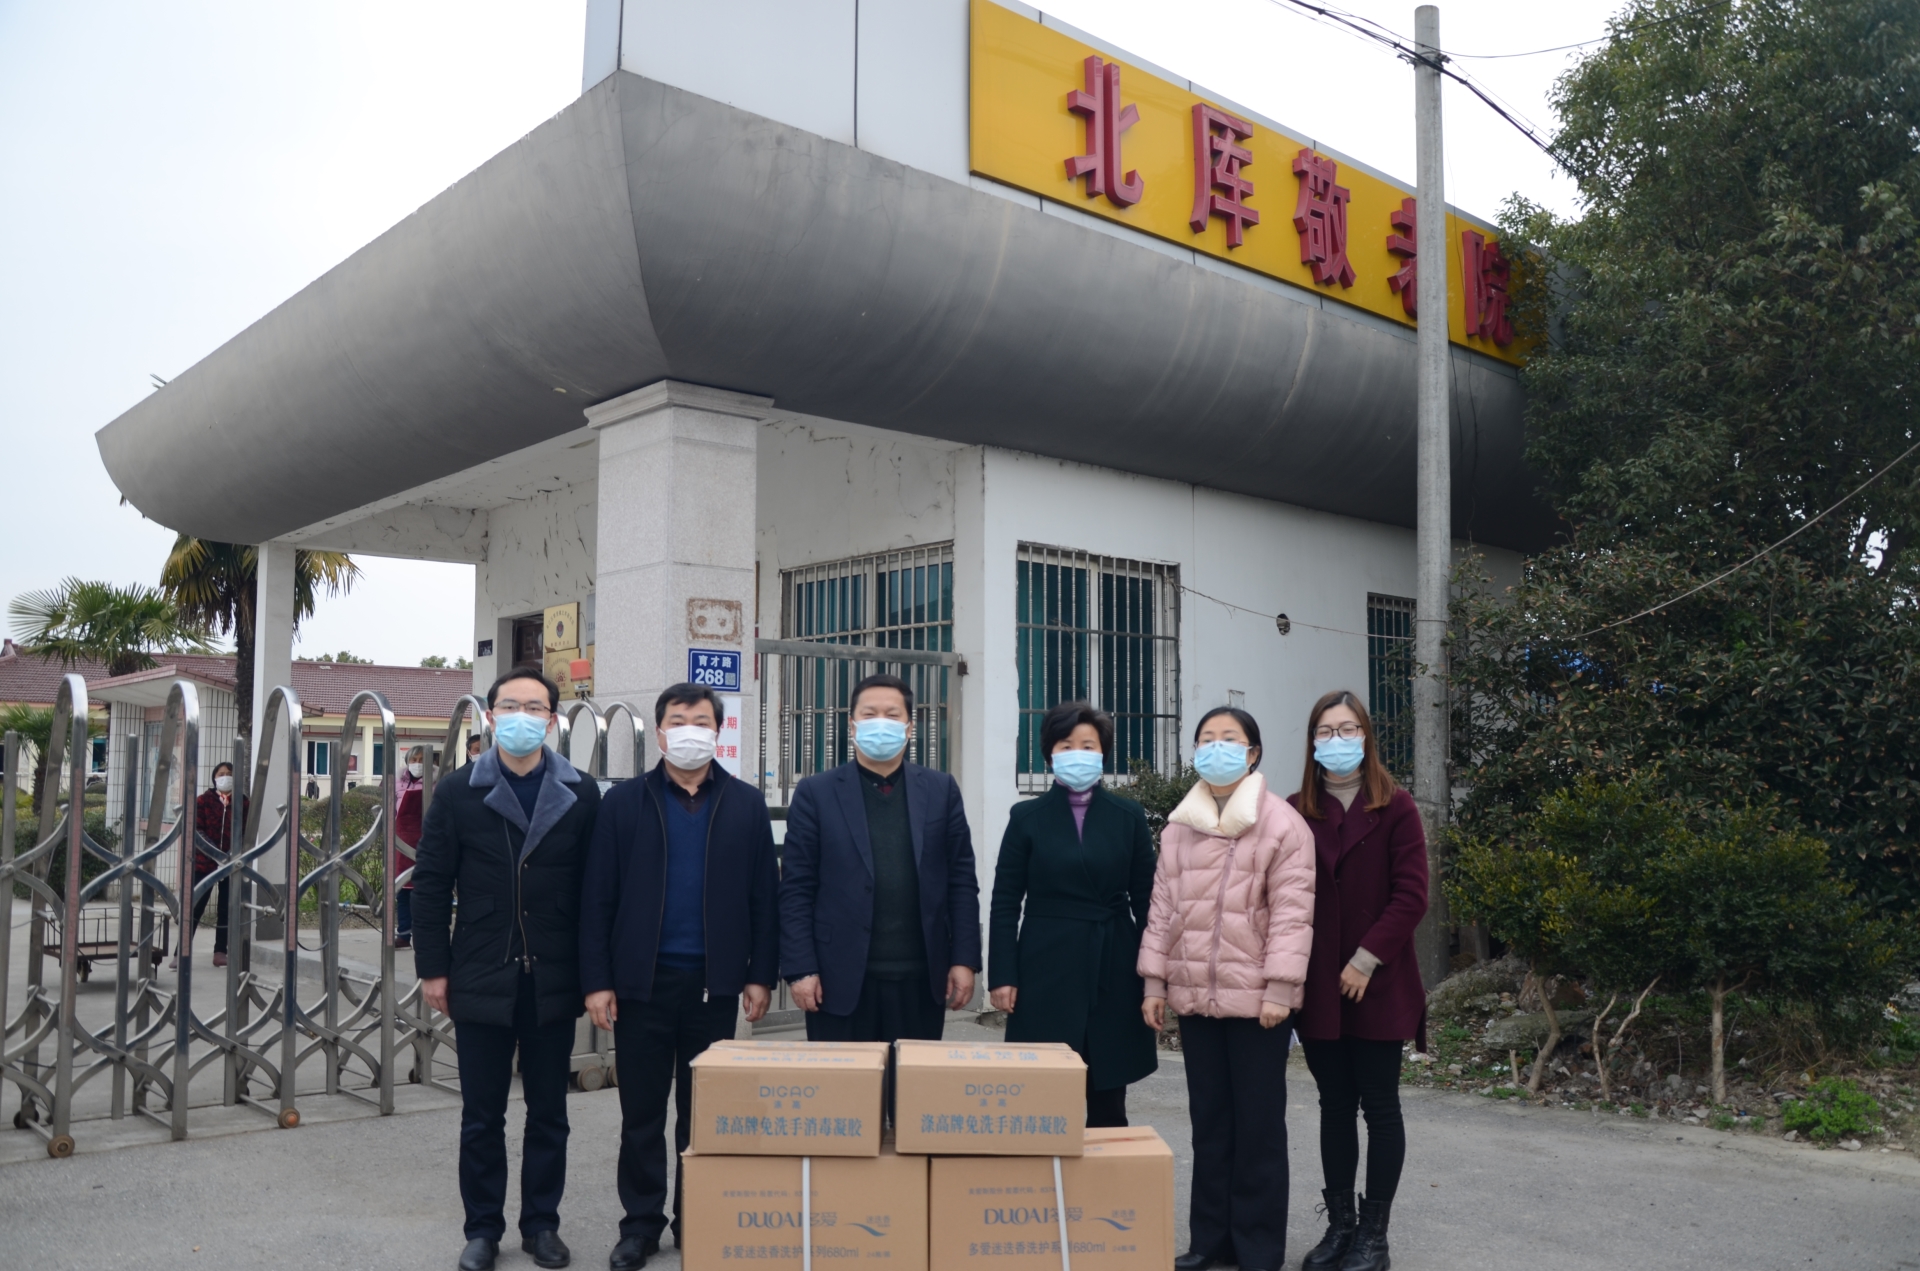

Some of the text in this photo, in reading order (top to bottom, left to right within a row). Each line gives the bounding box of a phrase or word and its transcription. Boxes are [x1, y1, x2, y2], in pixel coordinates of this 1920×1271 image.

[698, 655, 732, 668] 育才路
[695, 668, 724, 685] 268
[715, 1115, 863, 1137] 涤高牌免洗手消毒凝胶
[921, 1114, 1068, 1135] 涤高牌免洗手消毒凝胶
[737, 1211, 803, 1229] DUOAI
[984, 1207, 1048, 1225] DUOAI
